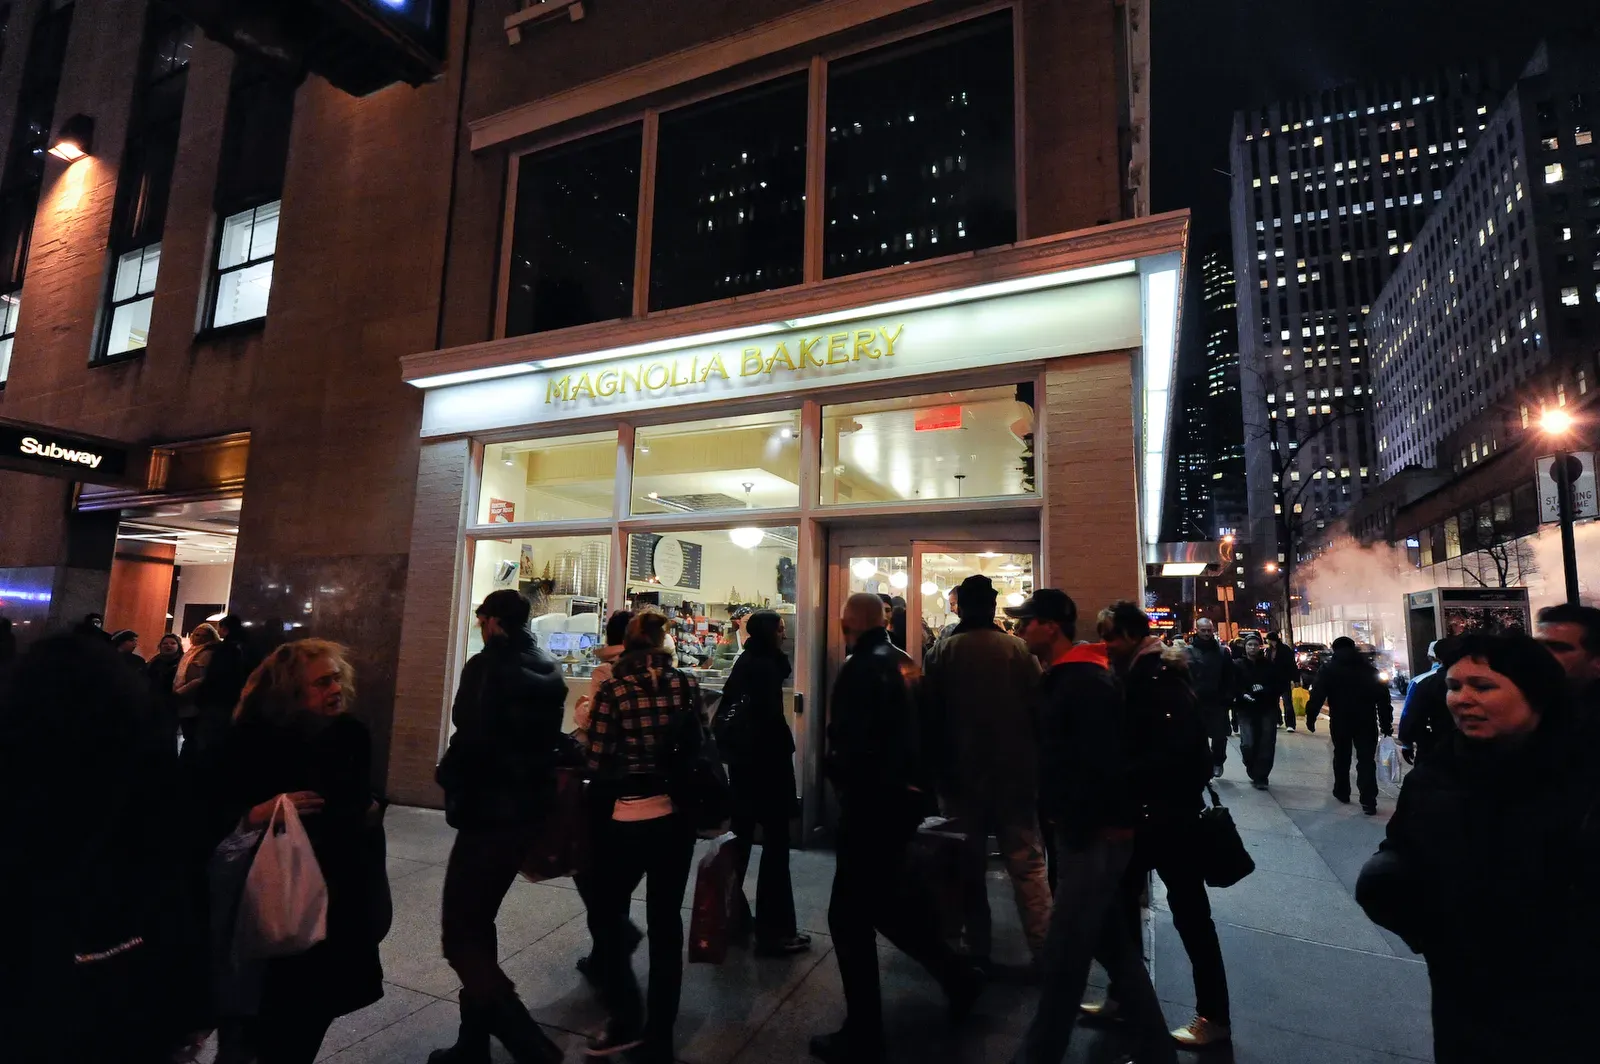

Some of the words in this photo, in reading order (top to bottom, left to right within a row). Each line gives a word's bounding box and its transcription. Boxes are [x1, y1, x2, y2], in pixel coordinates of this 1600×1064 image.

[545, 352, 730, 404] MAGNOLIA
[740, 323, 904, 377] BAKERY
[21, 437, 102, 468] Subway
